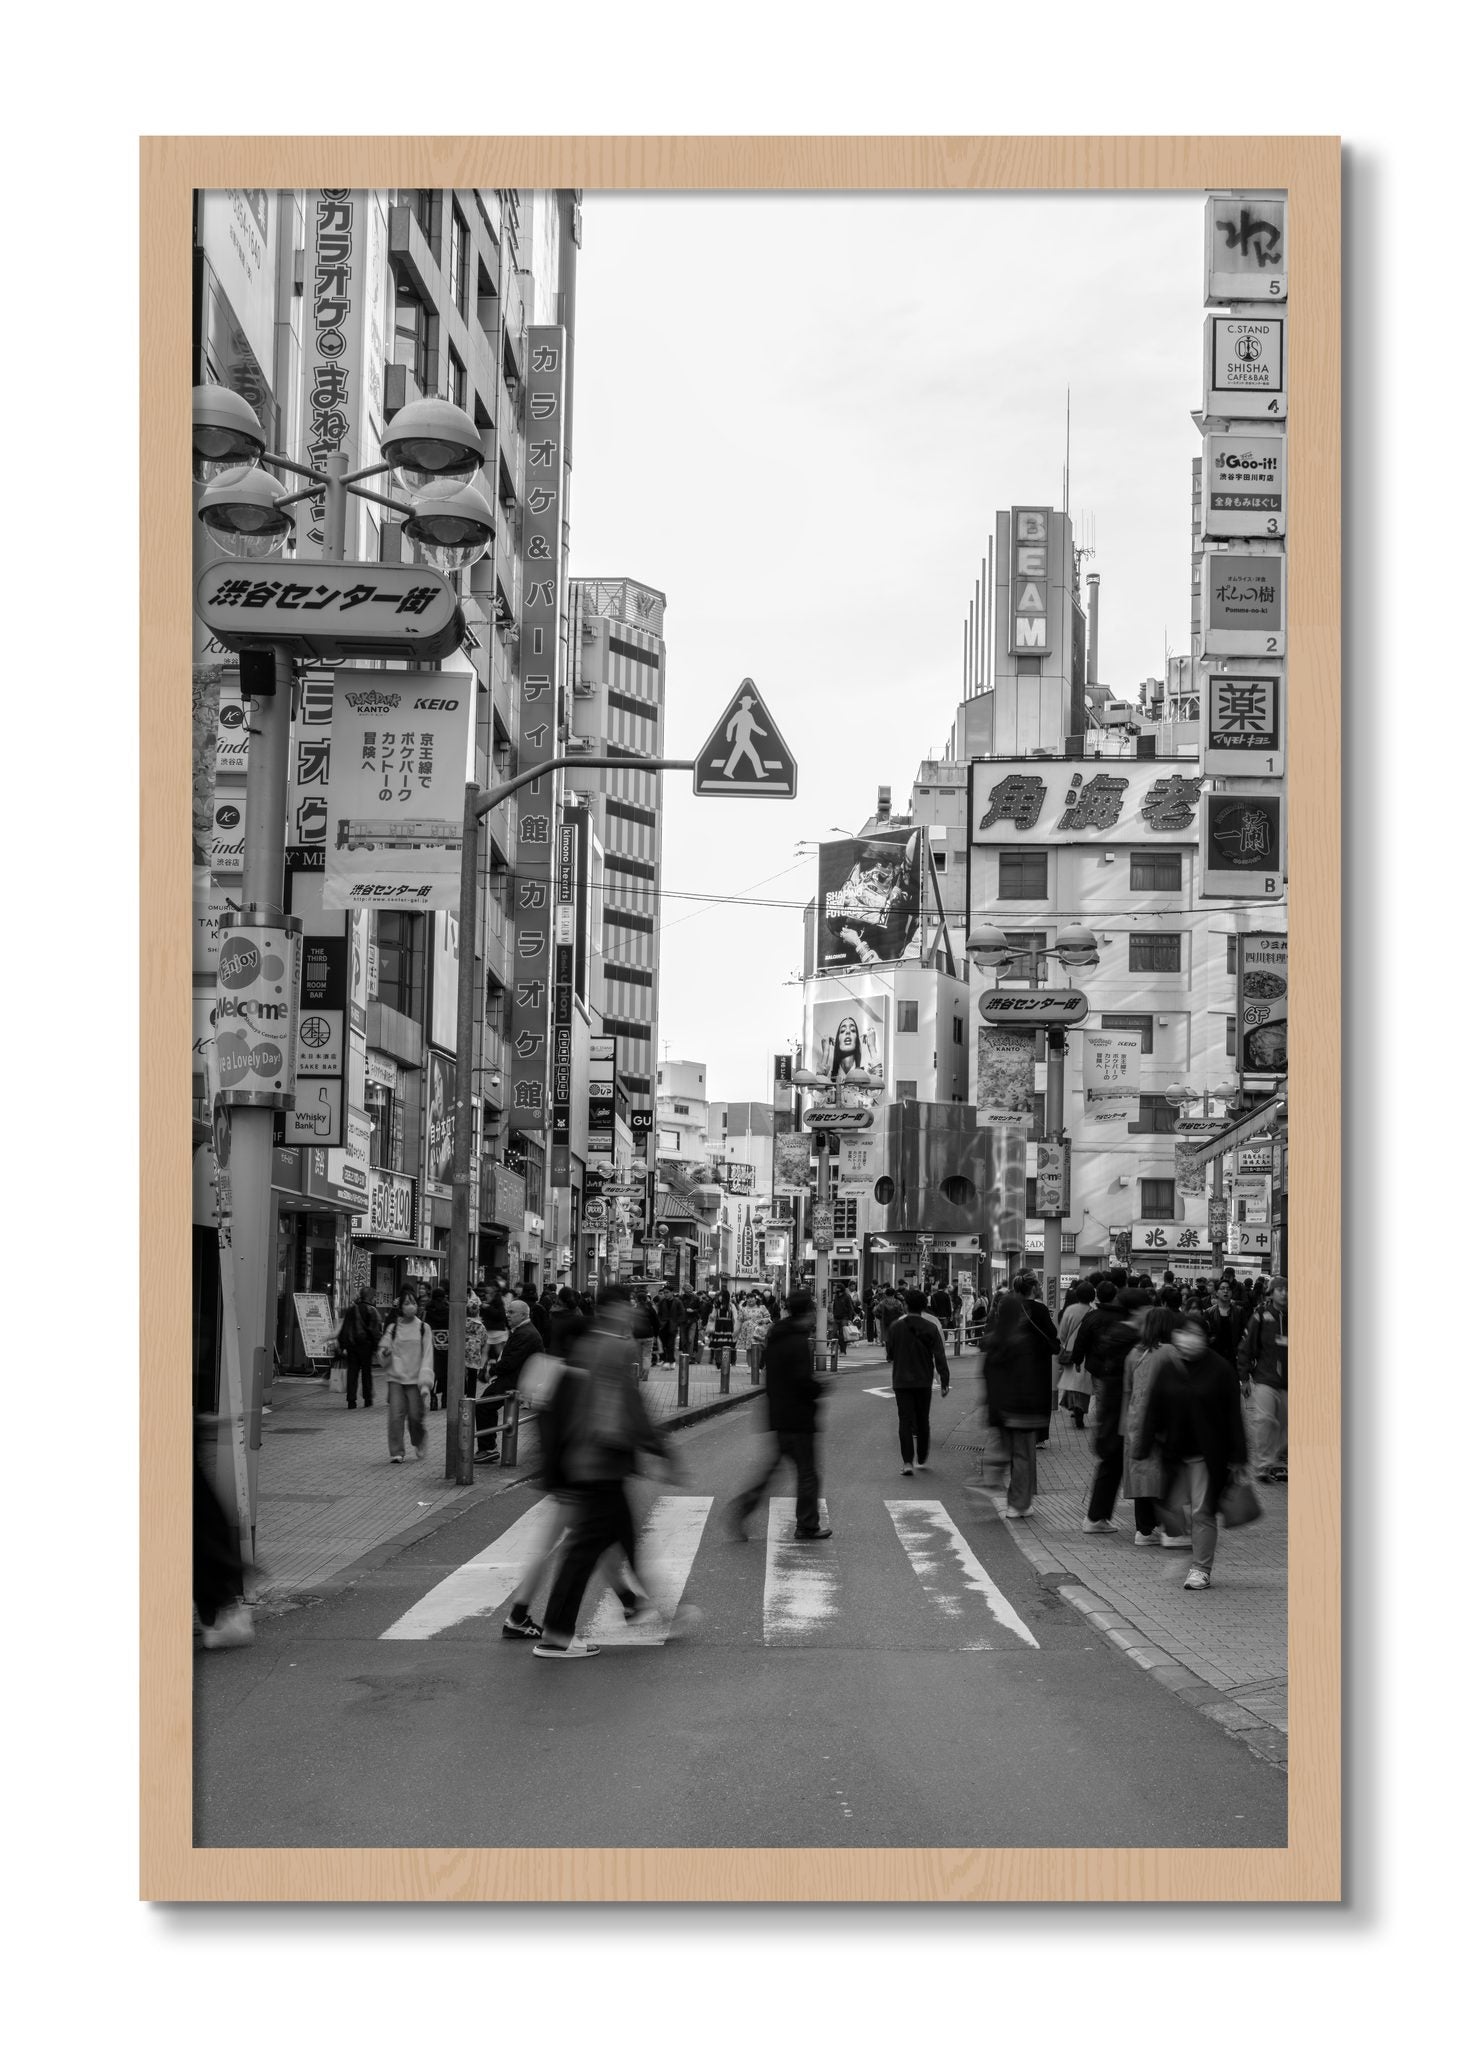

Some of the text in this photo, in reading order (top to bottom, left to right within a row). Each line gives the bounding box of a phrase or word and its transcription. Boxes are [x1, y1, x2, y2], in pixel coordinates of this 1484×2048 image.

[314, 201, 352, 330] カラオケ
[1269, 281, 1280, 295] 5
[1227, 325, 1270, 334] C.STAND
[1227, 363, 1269, 373] SHISHA
[1227, 373, 1269, 381] CAFE&BAR
[1226, 455, 1277, 470] Goo-it!
[1215, 497, 1278, 507] 全身もみほぐし
[1267, 518, 1278, 533] 3
[1015, 511, 1047, 647] BEAM
[208, 579, 442, 614] 渋谷センター街
[1215, 585, 1276, 603] ポムの樹
[1266, 638, 1277, 651] 2
[413, 698, 459, 711] KEIO
[1218, 683, 1266, 730] 薬
[1213, 733, 1271, 747] マツモトキヨシ
[361, 731, 377, 772] 冒険へ
[220, 758, 244, 766] 渋谷店
[379, 732, 395, 801] カントーの
[418, 733, 434, 789] 京王線で
[1265, 758, 1274, 772] 1
[979, 773, 1202, 831] 角海老
[1213, 810, 1271, 855] 一蘭
[216, 858, 240, 867] 渋谷店
[561, 829, 571, 899] kimono hearts
[349, 884, 433, 897] 渋谷センター街
[1265, 878, 1276, 892] B
[220, 950, 258, 982] Enjoy
[306, 981, 327, 989] ROOM
[309, 991, 323, 999] BAR
[513, 882, 547, 1111] カラオケ館
[216, 996, 289, 1020] Welcome
[985, 998, 1082, 1010] 渋谷センター街
[1244, 1006, 1270, 1024] 6F
[232, 1051, 260, 1069] Lovely
[262, 1052, 281, 1064] Day!
[295, 1113, 327, 1124] Whisky
[633, 1116, 652, 1126] GU
[806, 1113, 865, 1121] 渋谷センター街
[1145, 1227, 1200, 1248] 兆楽
